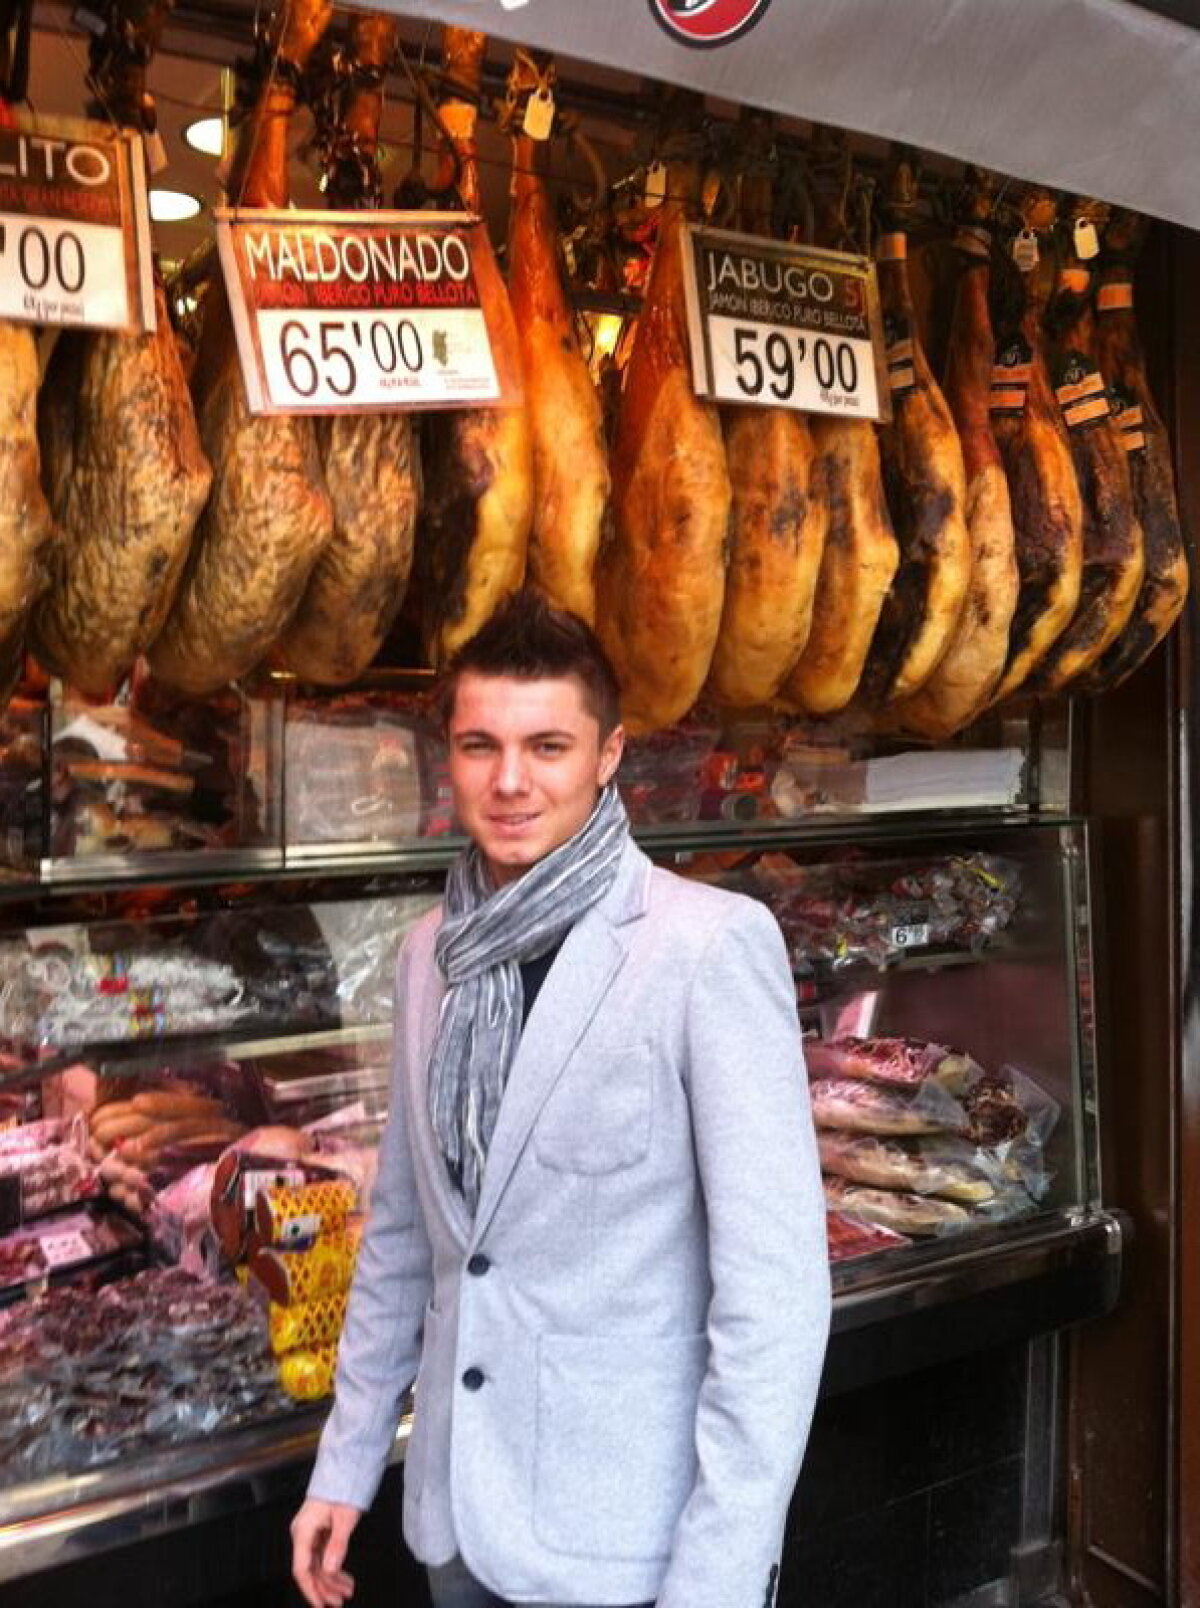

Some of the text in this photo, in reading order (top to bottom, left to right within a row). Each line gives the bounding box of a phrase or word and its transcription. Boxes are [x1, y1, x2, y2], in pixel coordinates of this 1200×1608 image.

[245, 231, 469, 282] MALDONADO
[708, 252, 833, 302] JABUGO
[374, 284, 413, 304] PURO
[279, 319, 424, 397] 65'00
